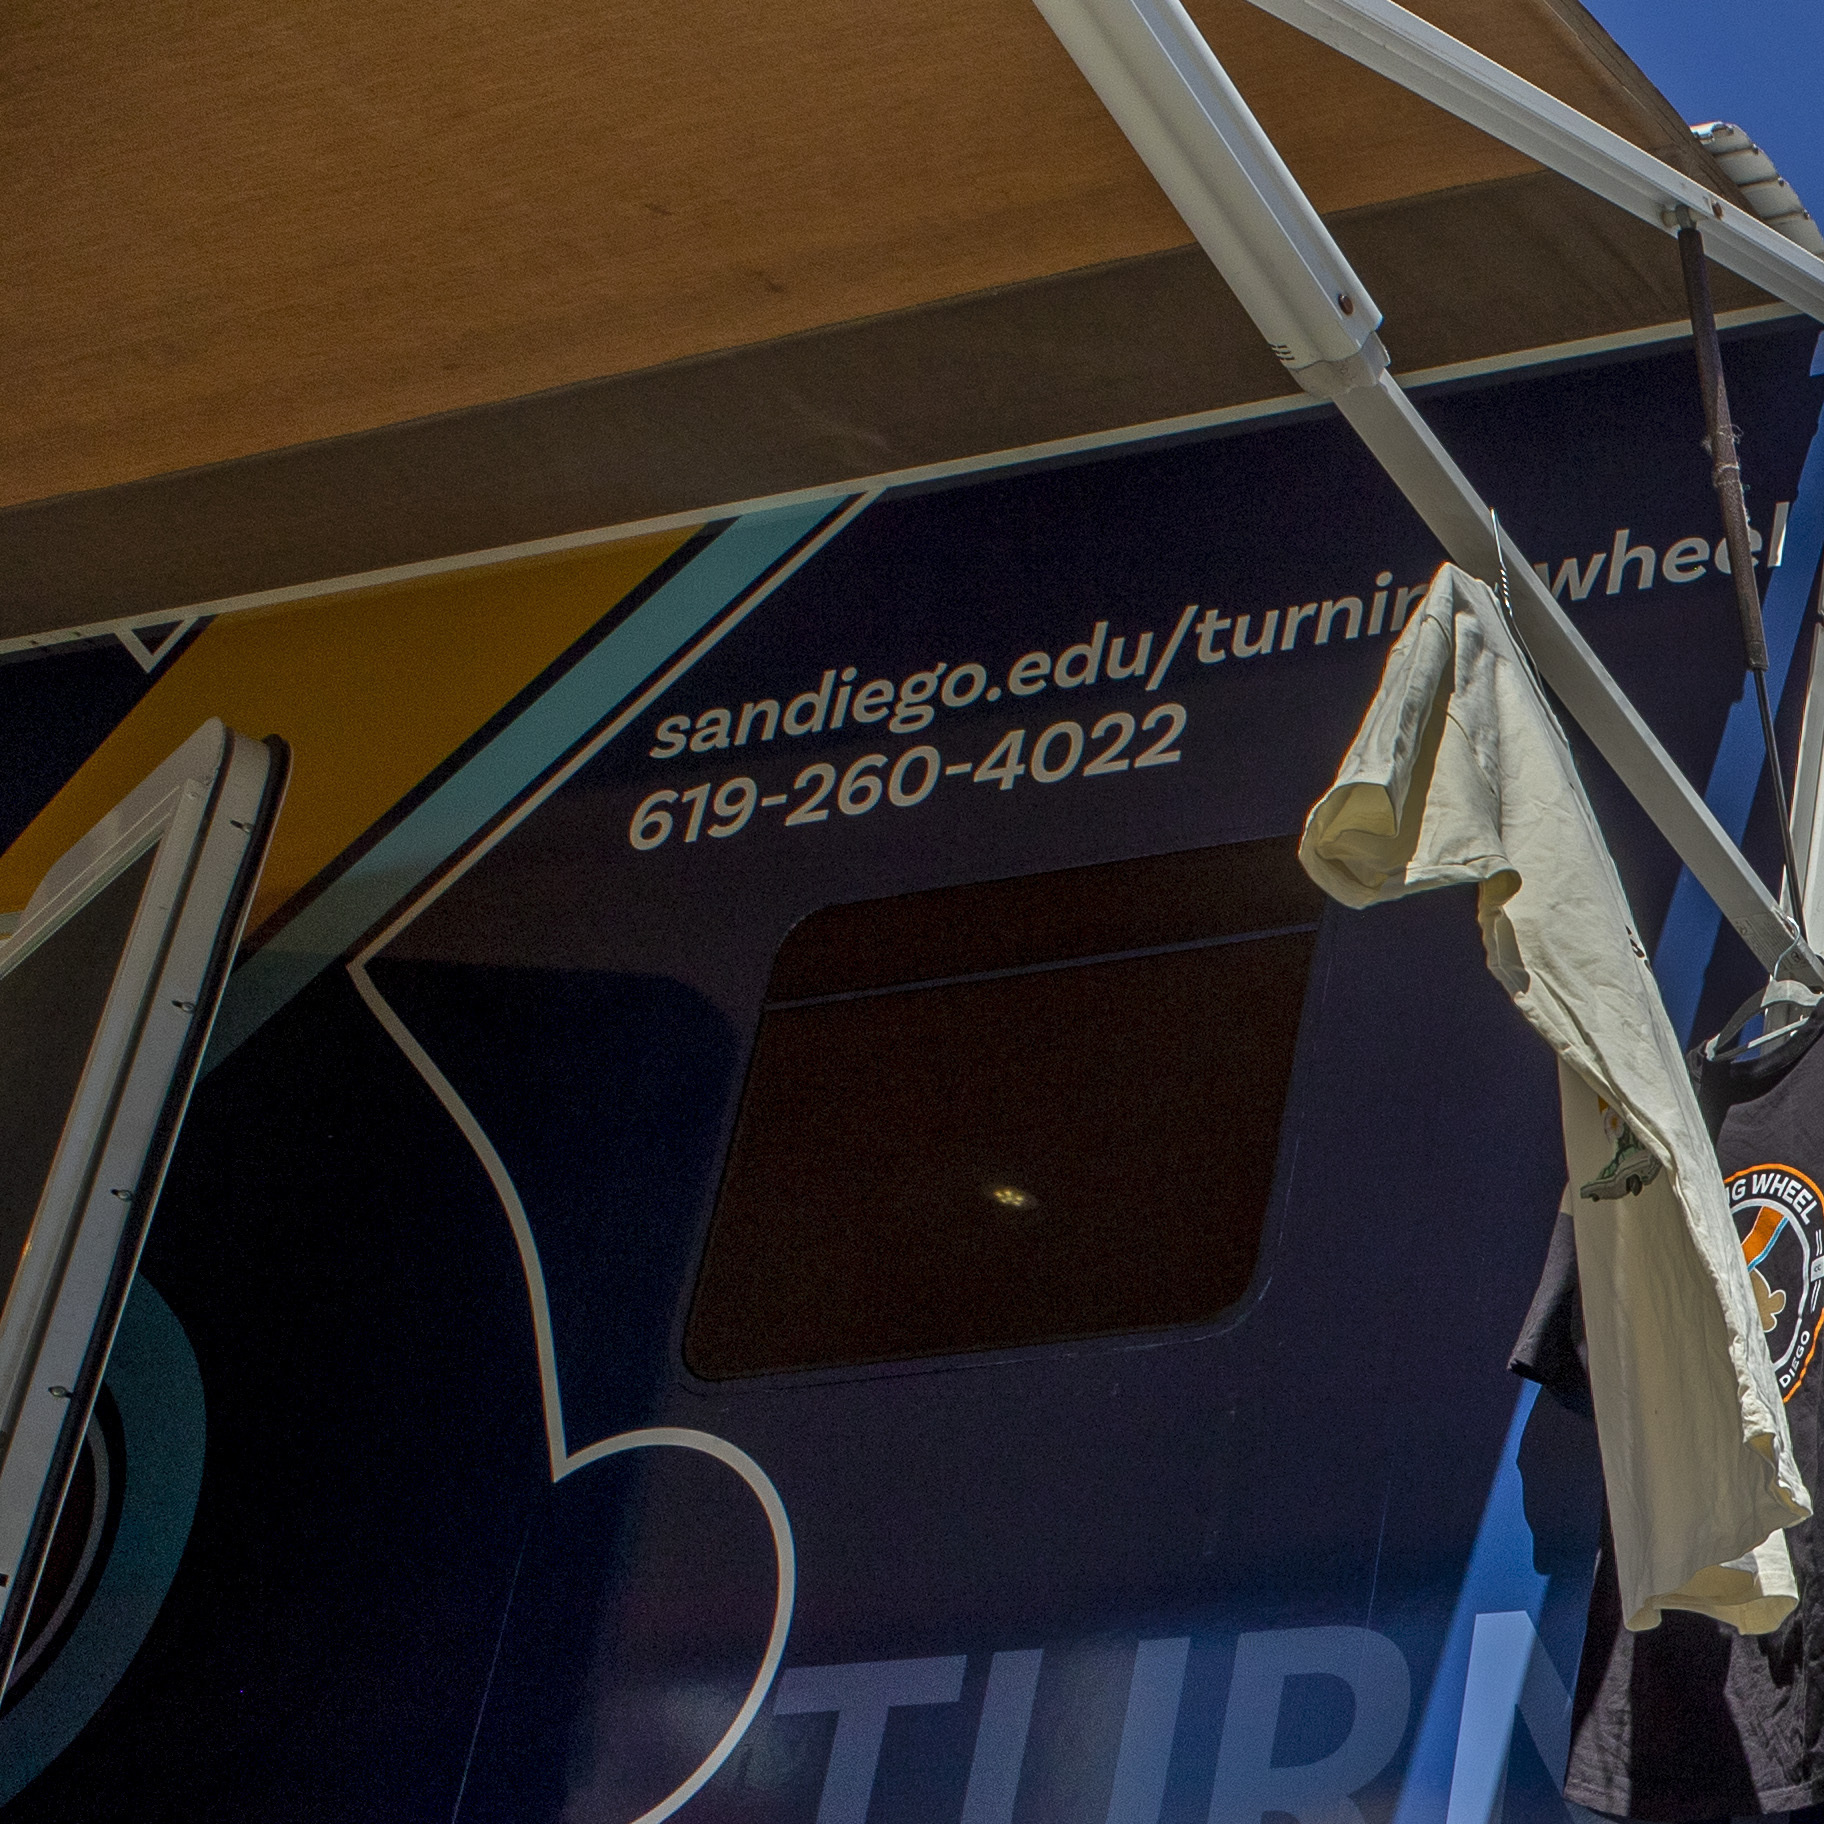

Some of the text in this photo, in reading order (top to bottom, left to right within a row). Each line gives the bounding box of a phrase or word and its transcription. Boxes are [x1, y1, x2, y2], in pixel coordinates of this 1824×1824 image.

[648, 501, 1789, 759] sandiego.edu/turninwheel
[629, 702, 1189, 851] 619-260-4022
[1751, 1173, 1818, 1224] WHEEL
[1778, 1330, 1811, 1389] DIEGO
